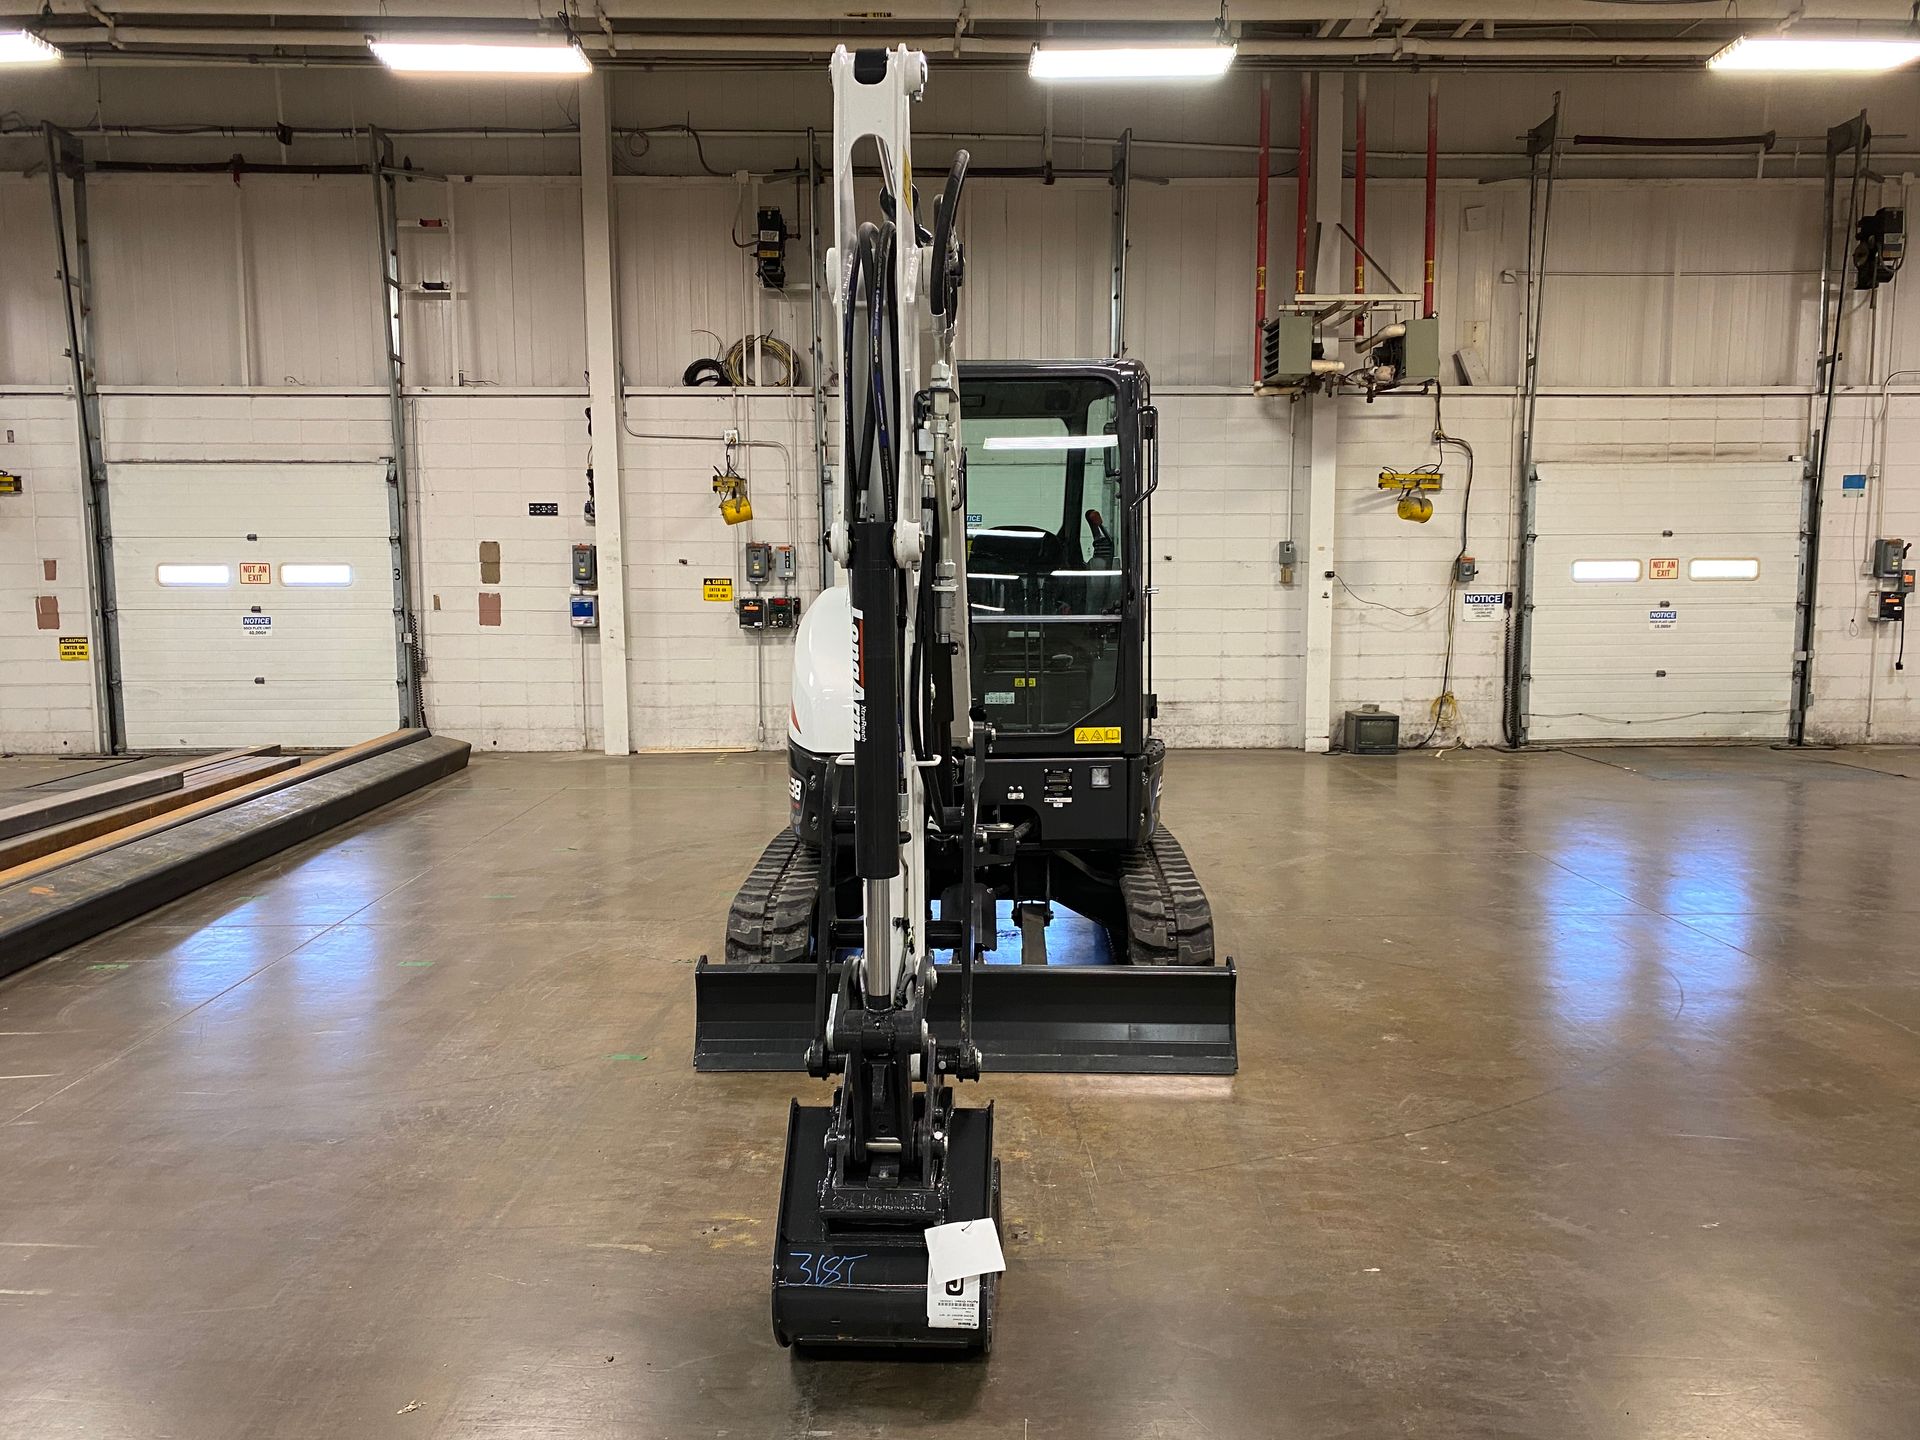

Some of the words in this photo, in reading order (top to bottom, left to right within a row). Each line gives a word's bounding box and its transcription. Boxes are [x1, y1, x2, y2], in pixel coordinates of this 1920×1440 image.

[243, 565, 256, 573] NOT
[258, 565, 267, 573] AN
[1653, 561, 1665, 569] NOT
[1667, 561, 1676, 569] AN
[393, 568, 401, 581] 3
[1656, 569, 1671, 577] EXIT
[248, 574, 263, 582] EXIT
[1466, 595, 1501, 603] NOTICE
[244, 617, 270, 625] NOTICE
